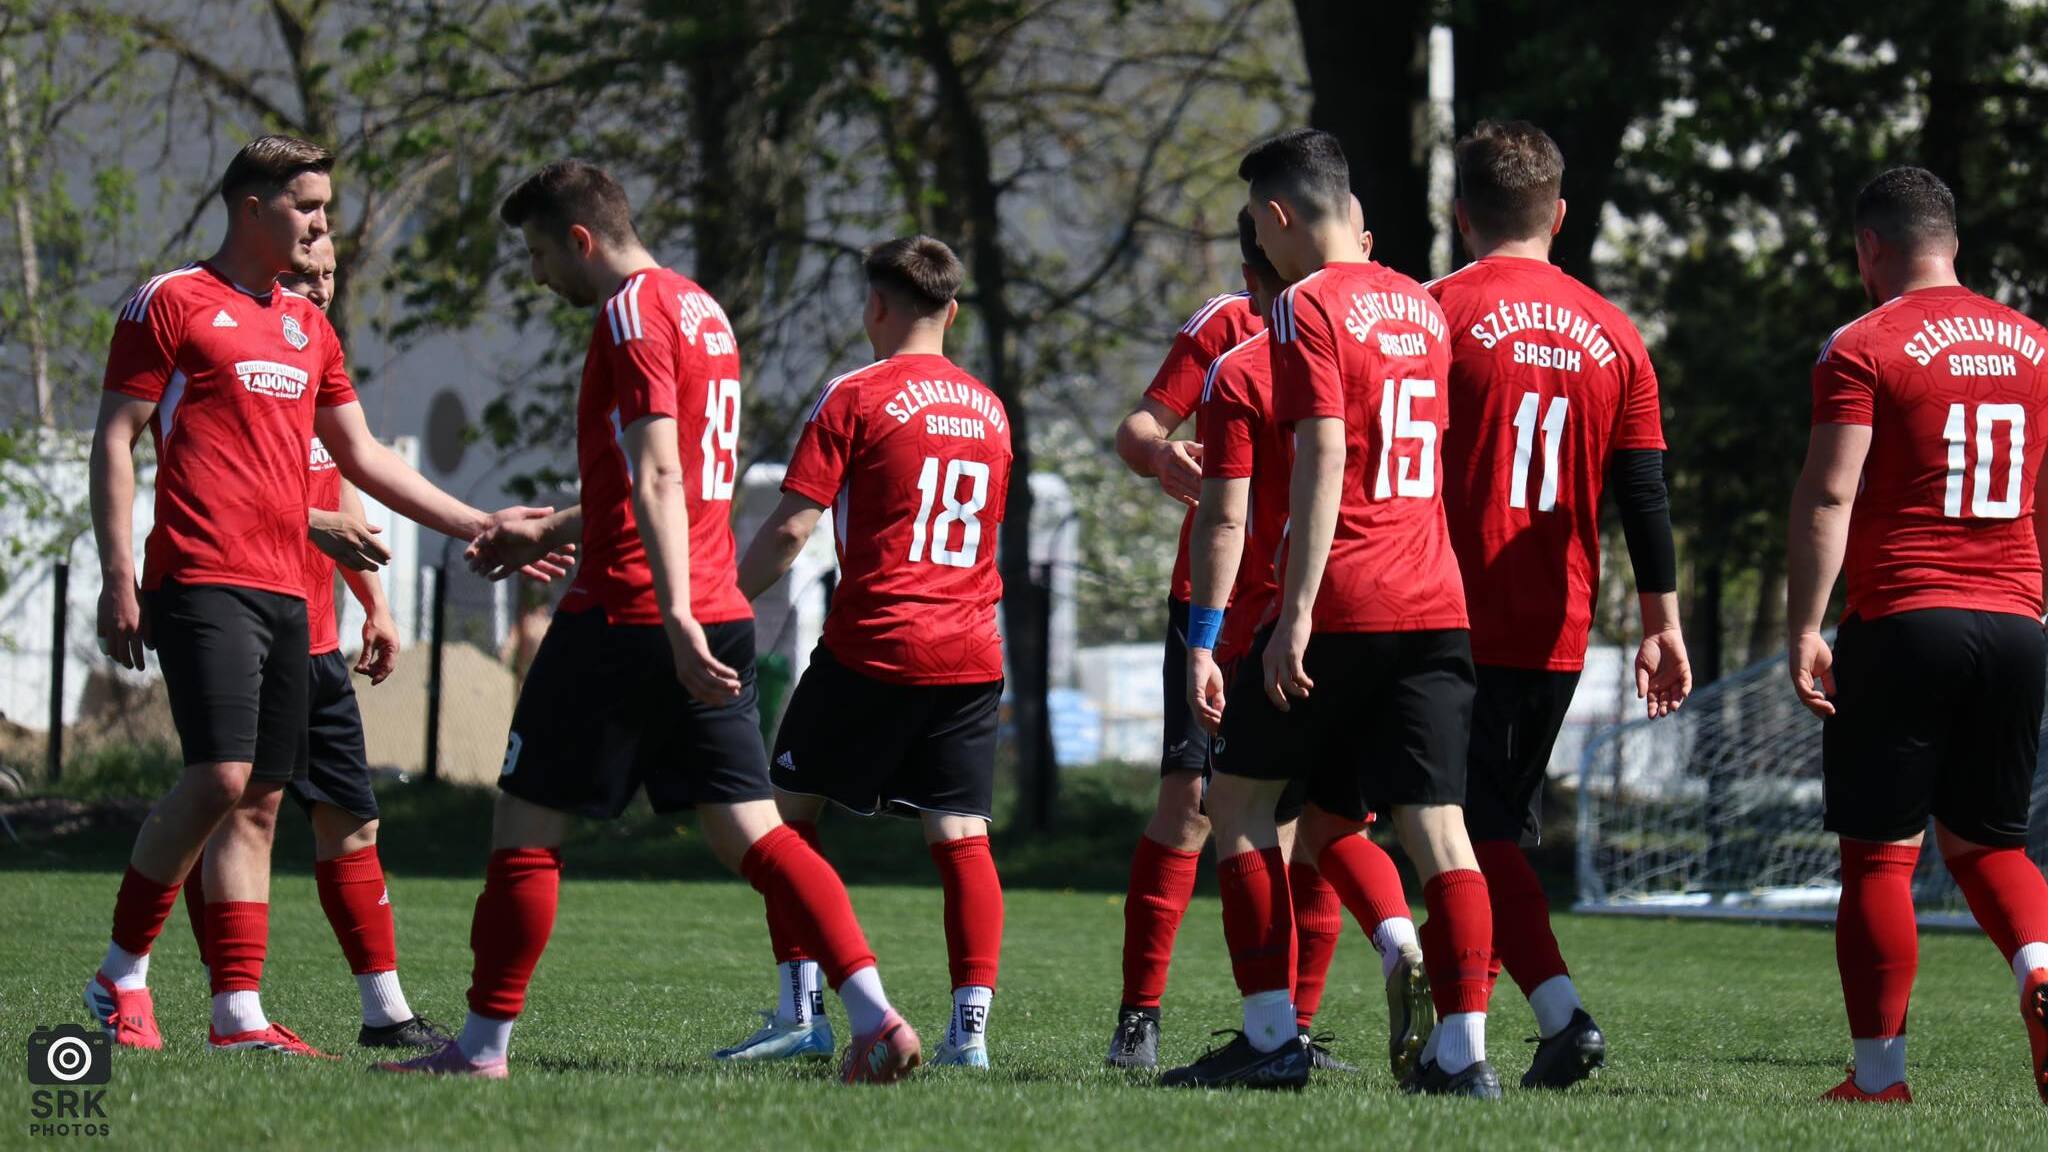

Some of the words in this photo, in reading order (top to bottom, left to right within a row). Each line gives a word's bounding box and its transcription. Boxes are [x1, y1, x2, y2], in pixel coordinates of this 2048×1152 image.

[1470, 299, 1616, 368] SZÉKELYHÍDI
[1513, 341, 1581, 373] SASOK
[1903, 316, 2045, 367] SZÉKELYHÍDI
[1948, 354, 2017, 376] SASOK
[701, 378, 741, 501] 19
[885, 379, 1005, 434] SZÉKELYHÍDI
[925, 414, 985, 440] SASOK
[1373, 378, 1437, 501] 15
[1509, 391, 1570, 512] 11
[1943, 403, 2026, 519] 10
[908, 456, 990, 569] 18
